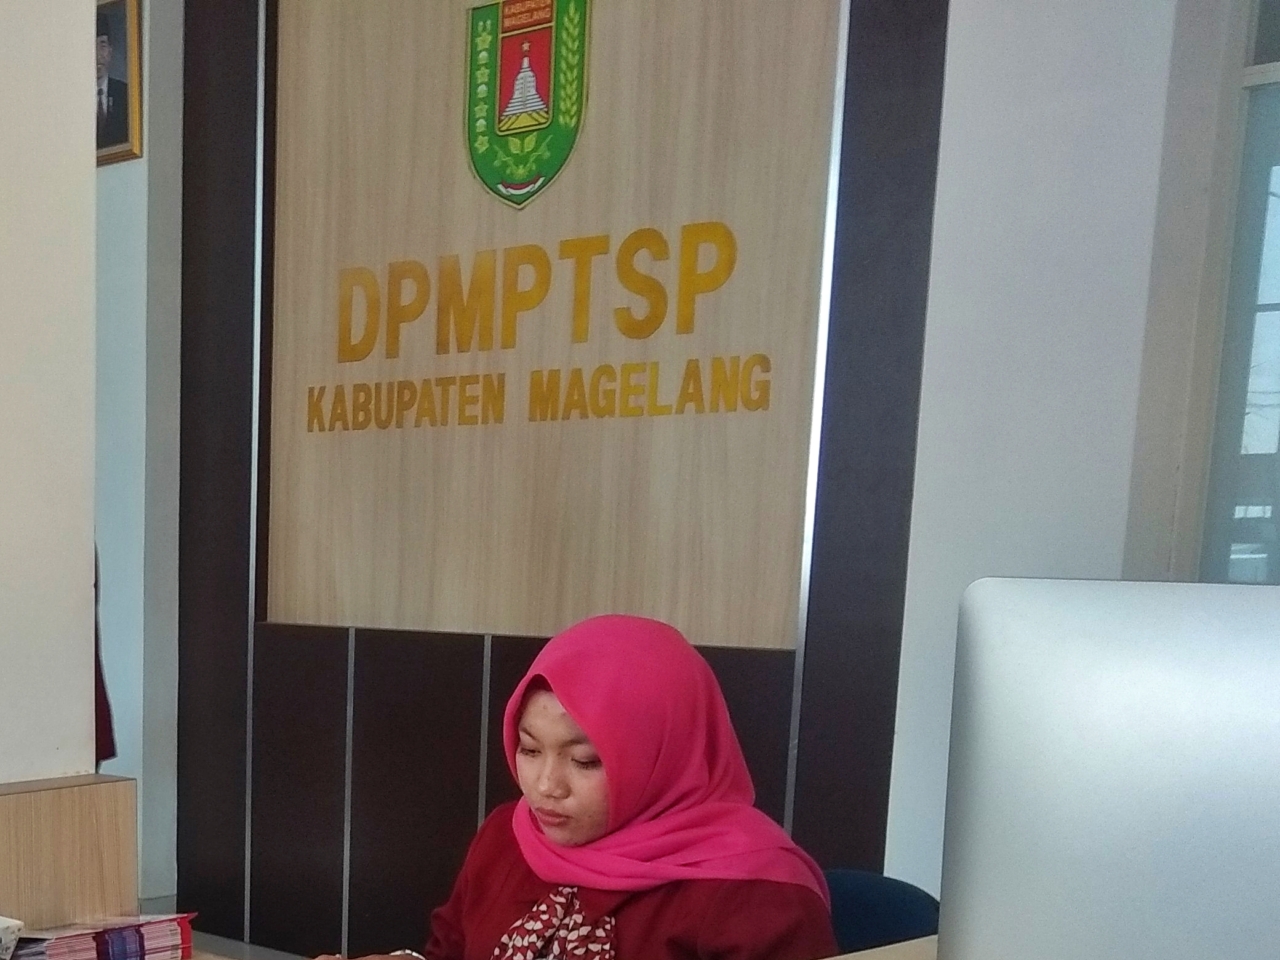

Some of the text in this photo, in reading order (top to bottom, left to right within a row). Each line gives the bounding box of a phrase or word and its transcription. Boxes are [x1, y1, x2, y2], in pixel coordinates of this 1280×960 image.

[337, 221, 737, 363] DPMPTSP
[307, 353, 772, 433] KABUPATEN MAGELANG
